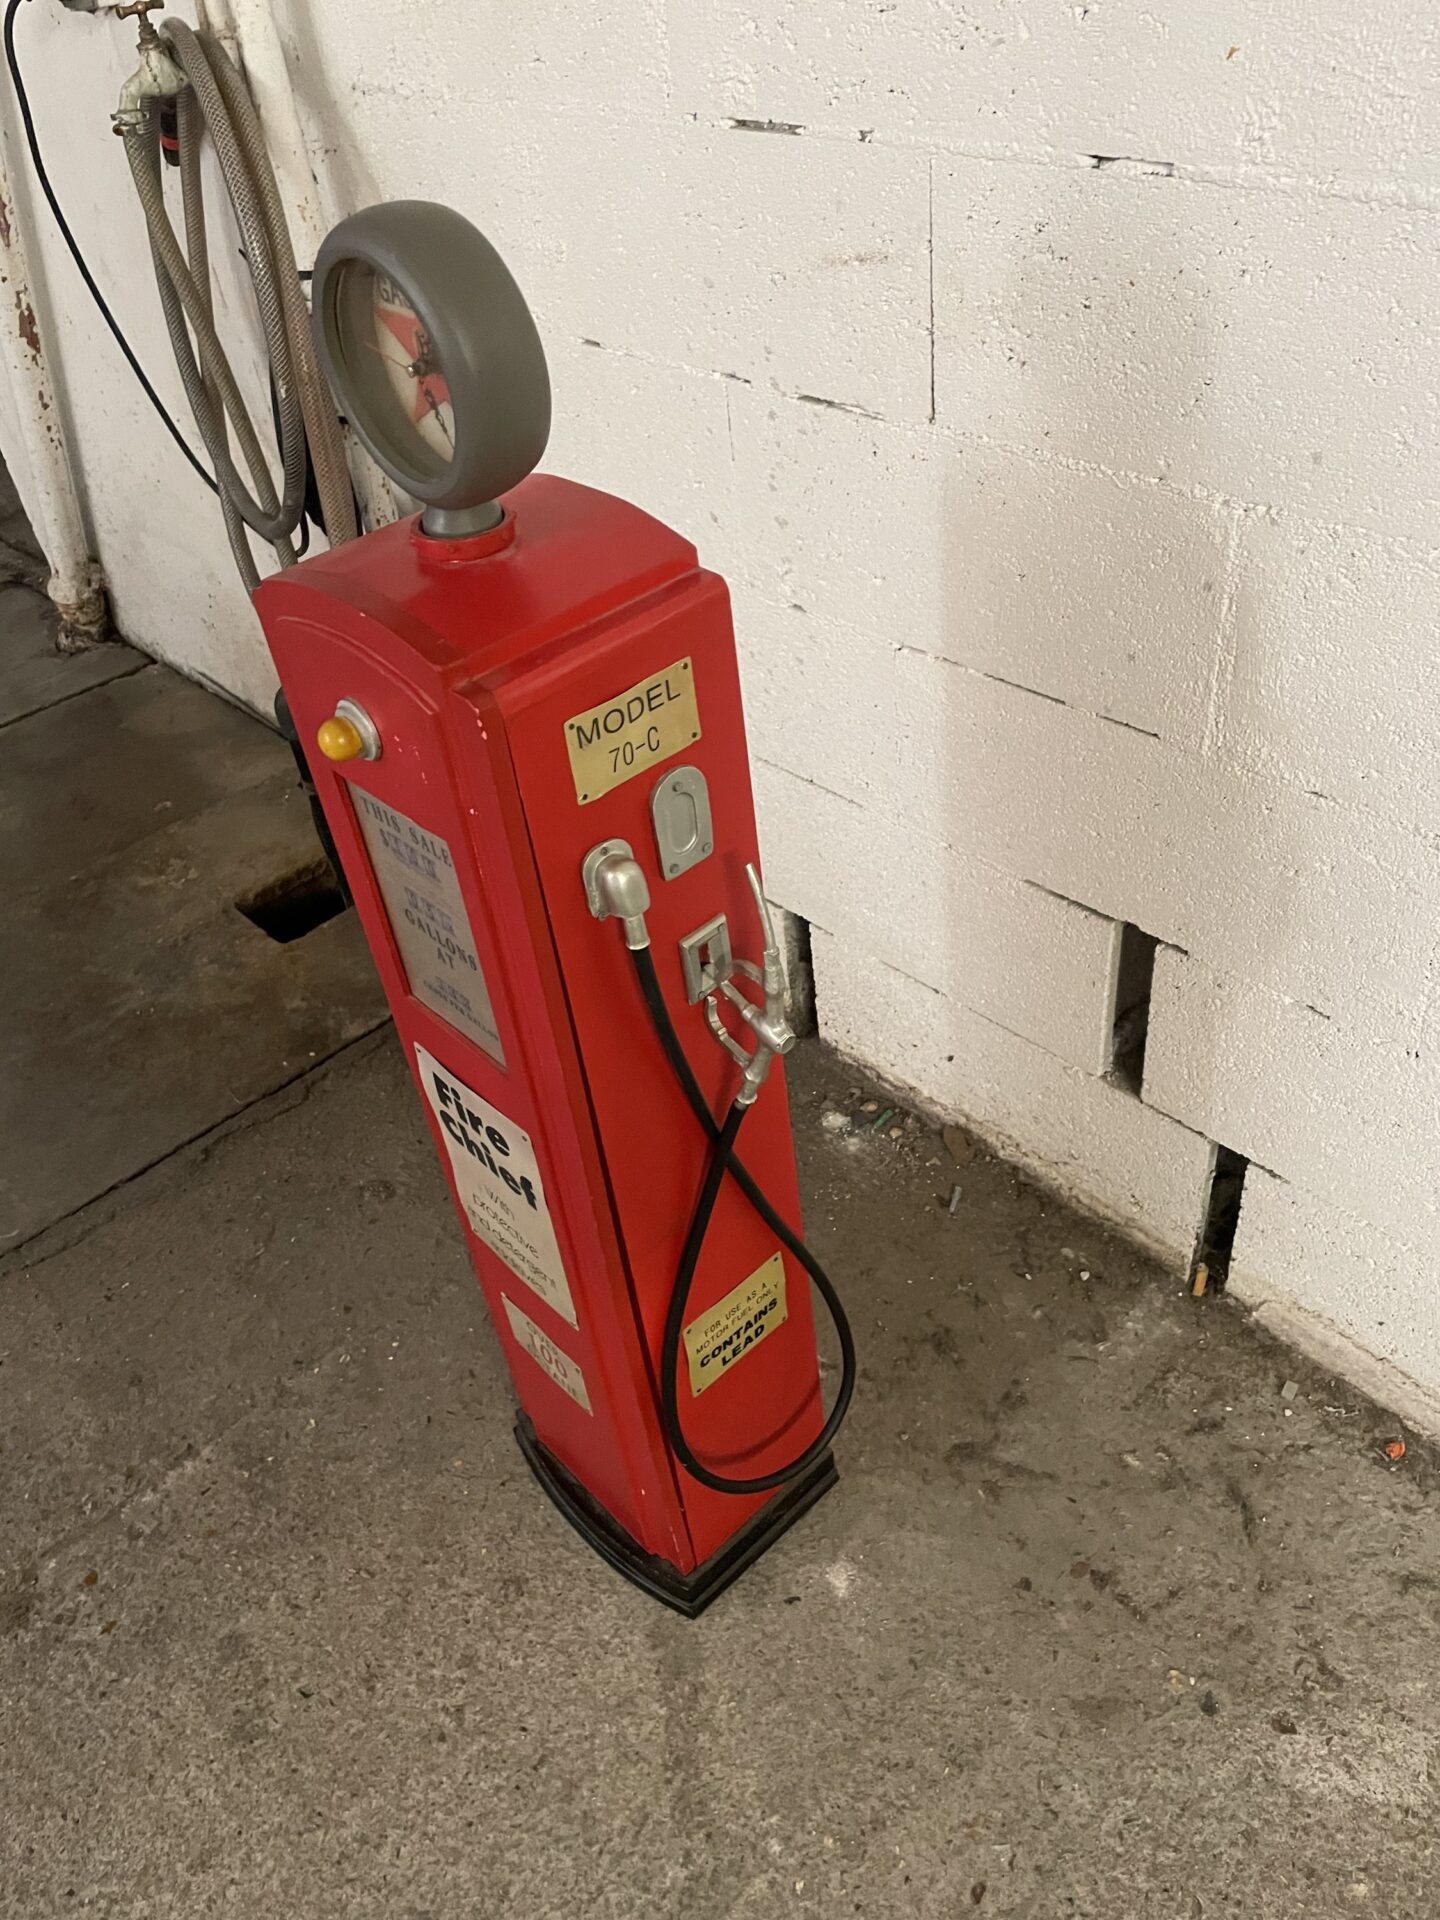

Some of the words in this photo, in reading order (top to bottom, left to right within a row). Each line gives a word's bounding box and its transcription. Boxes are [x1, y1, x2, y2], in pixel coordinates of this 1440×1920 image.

[576, 680, 681, 749] MODEL
[609, 726, 660, 773] 70-C
[360, 796, 401, 833] THIS
[409, 827, 452, 868] SALE
[405, 909, 477, 971] GALLONS
[437, 947, 454, 970] AT
[432, 1071, 510, 1157] Fire
[439, 1109, 538, 1212] Chief
[696, 1324, 729, 1355] MOTOR
[731, 1306, 754, 1326] FUEL
[756, 1282, 779, 1304] ONLY
[700, 1298, 778, 1368] CONTAINS
[704, 1319, 721, 1337] FOR
[725, 1302, 742, 1320] USE
[746, 1290, 757, 1303] AS
[761, 1282, 768, 1290] A
[721, 1324, 766, 1367] LEAD
